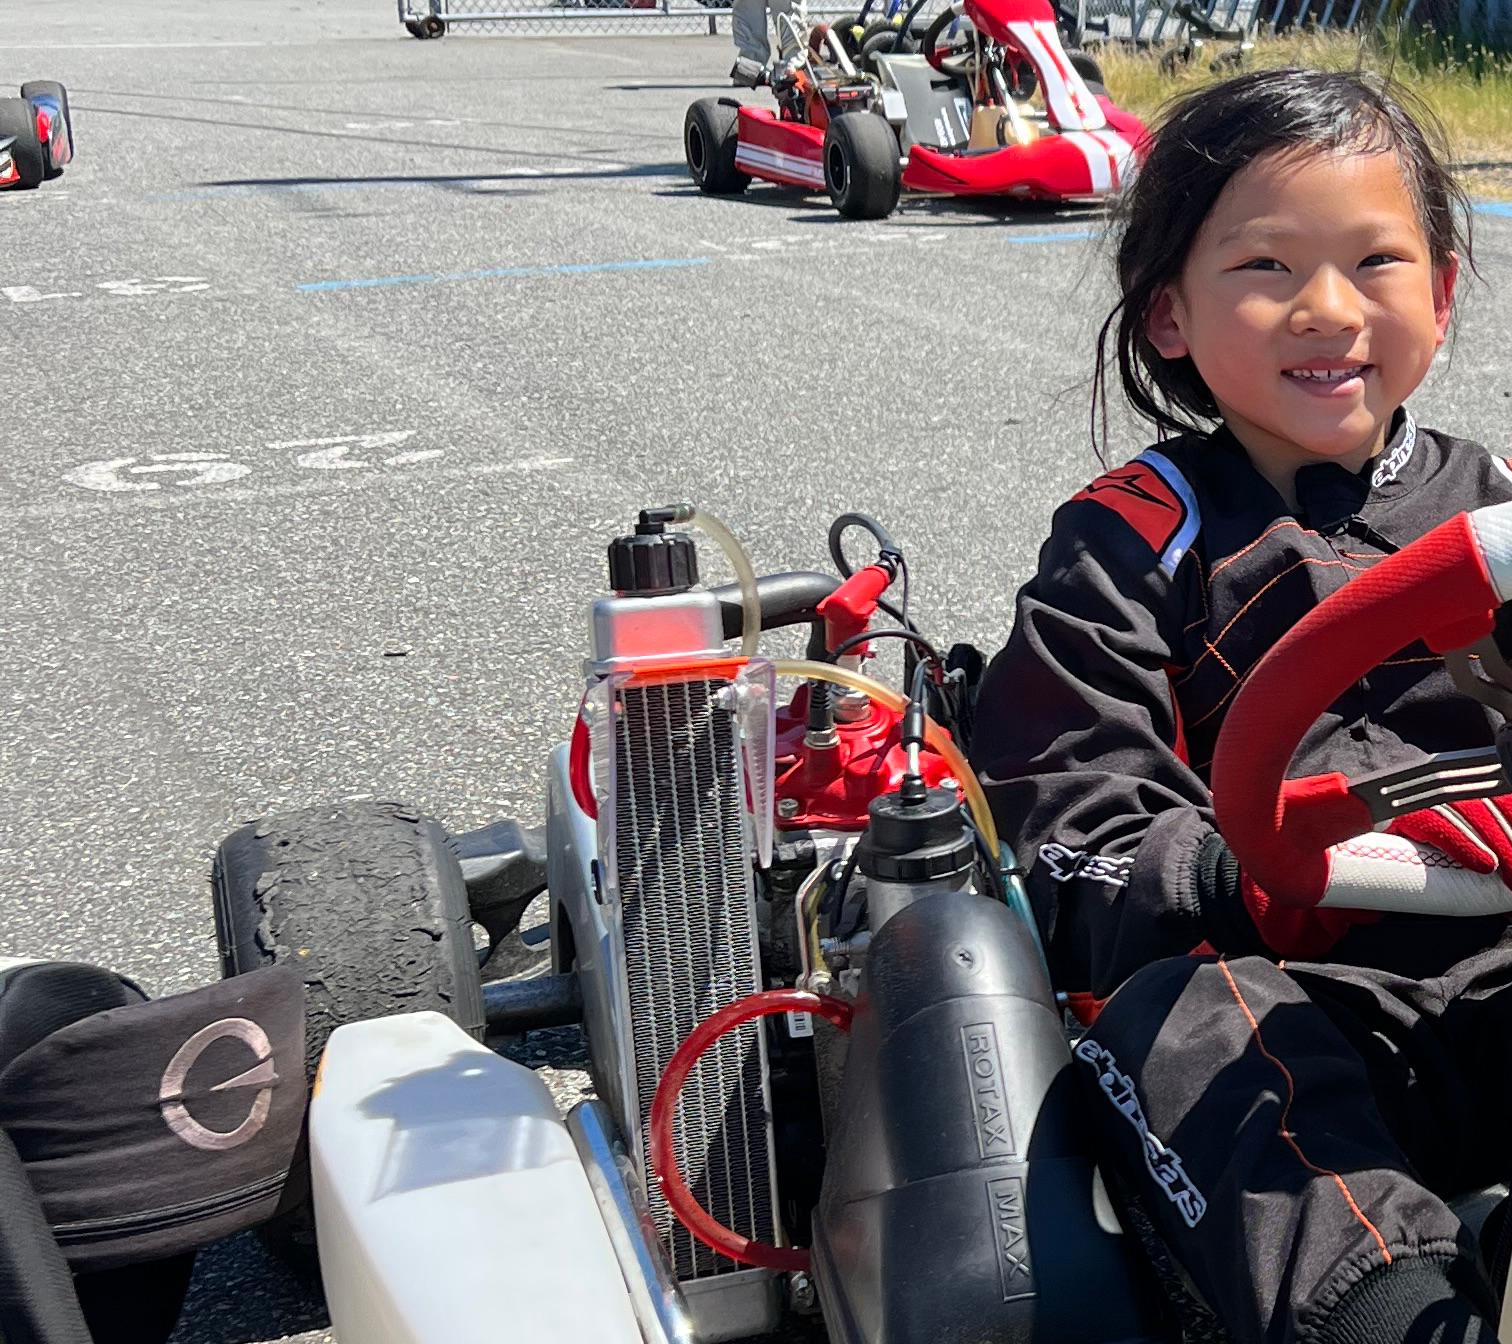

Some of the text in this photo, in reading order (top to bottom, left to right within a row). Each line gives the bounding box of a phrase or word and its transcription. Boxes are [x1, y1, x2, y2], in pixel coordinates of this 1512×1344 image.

[970, 1032, 1007, 1147] ROTAX
[1076, 1040, 1207, 1228] alpintars
[995, 1191, 1030, 1281] MAX
